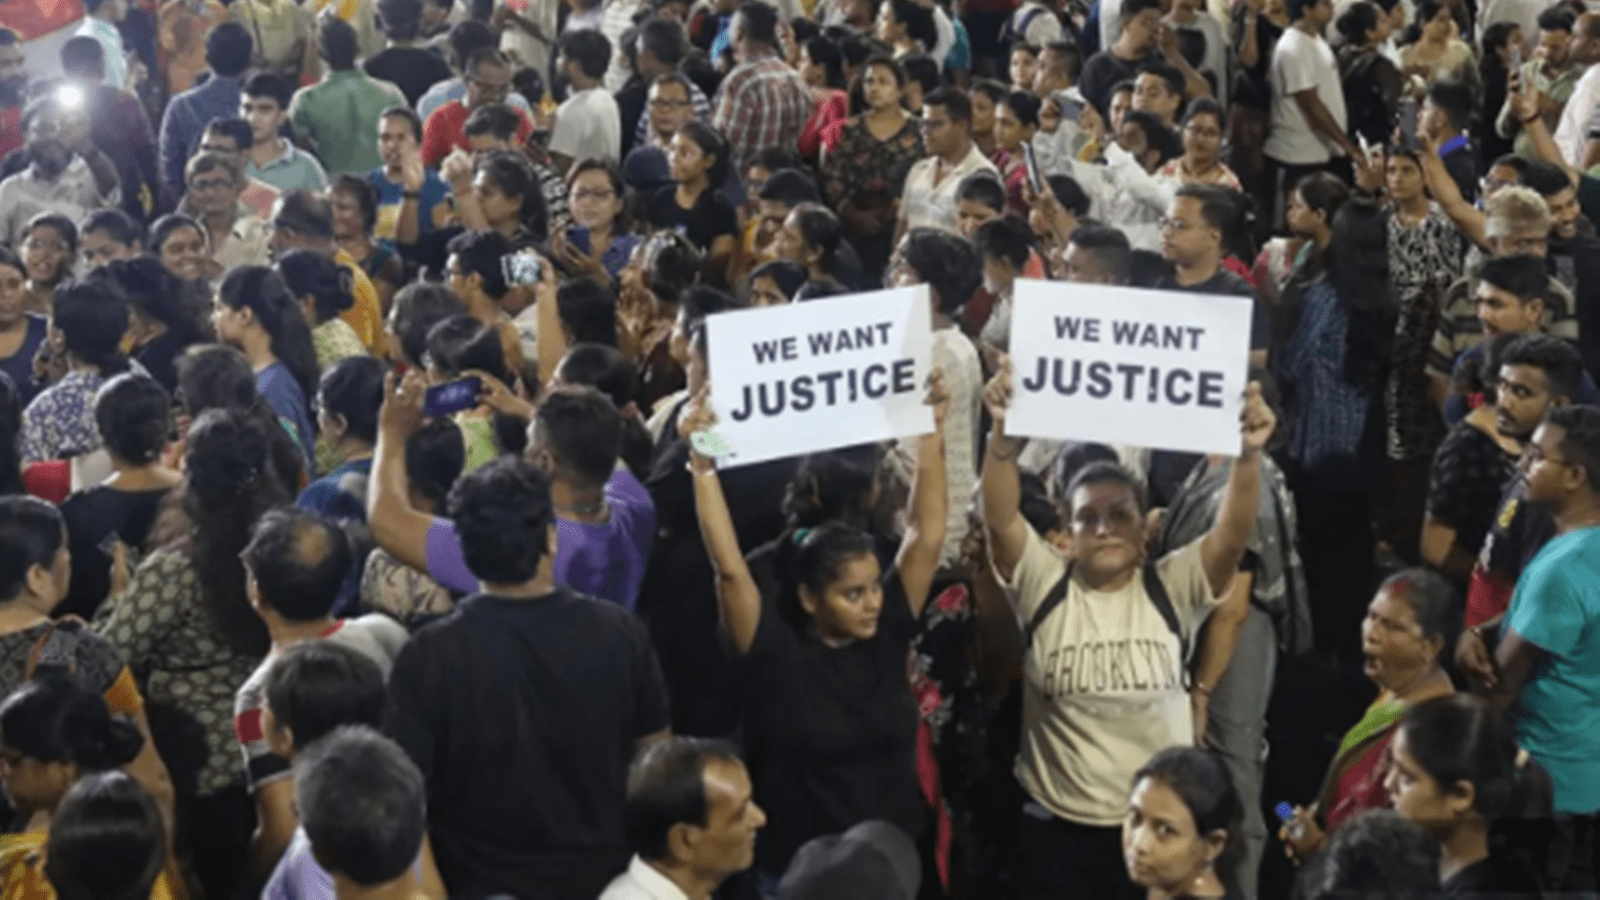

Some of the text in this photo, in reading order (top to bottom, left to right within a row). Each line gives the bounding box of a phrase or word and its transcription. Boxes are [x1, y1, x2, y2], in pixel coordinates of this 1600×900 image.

[752, 322, 892, 364] WE WANT
[1054, 316, 1204, 350] WE WANT
[1043, 638, 1182, 701] BROOKLYN
